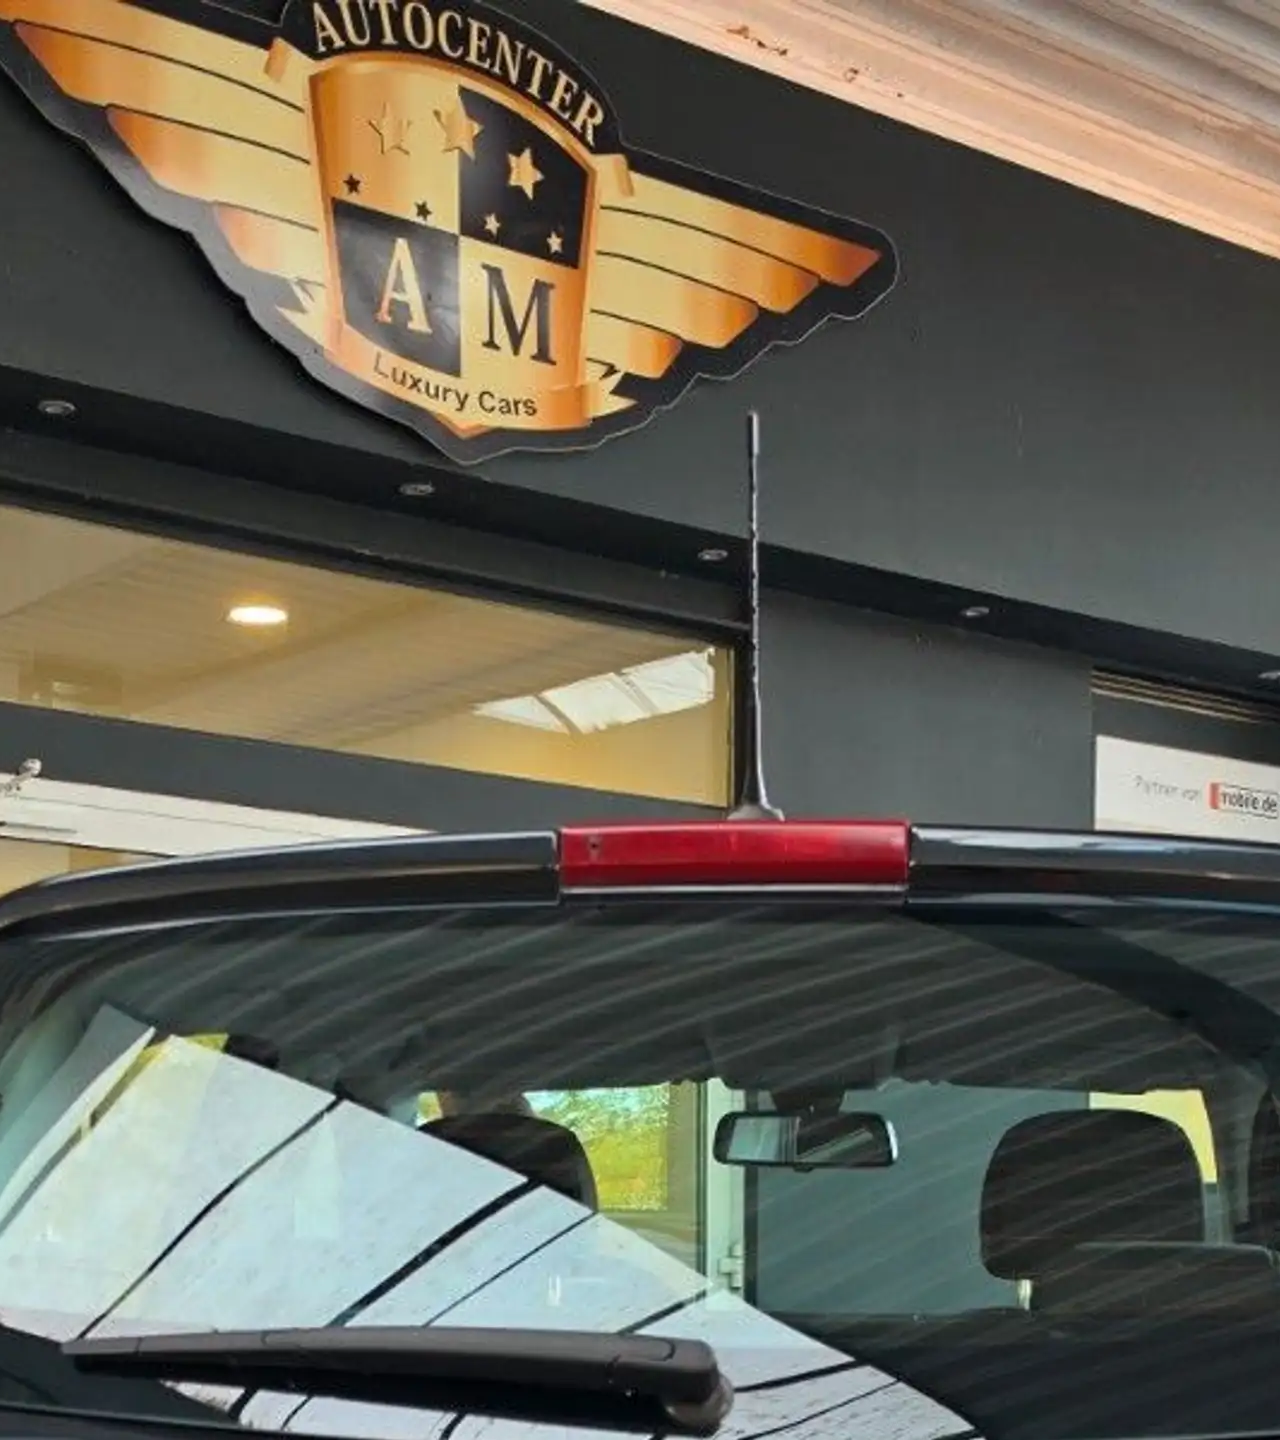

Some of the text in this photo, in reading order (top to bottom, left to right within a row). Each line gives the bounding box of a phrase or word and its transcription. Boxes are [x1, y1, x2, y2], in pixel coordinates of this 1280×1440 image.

[313, 0, 606, 147] AUTOCENTER
[376, 238, 557, 366] A M
[374, 351, 537, 416] Luxury Cars
